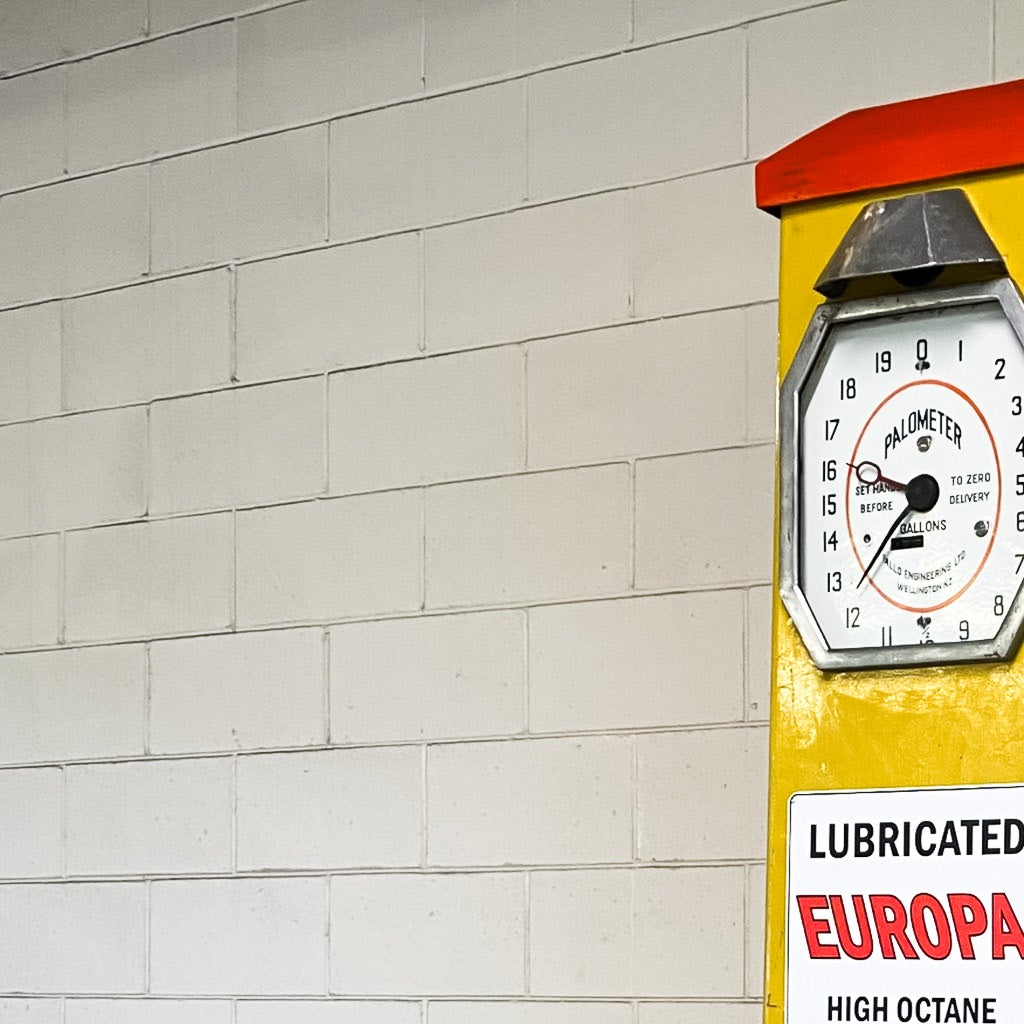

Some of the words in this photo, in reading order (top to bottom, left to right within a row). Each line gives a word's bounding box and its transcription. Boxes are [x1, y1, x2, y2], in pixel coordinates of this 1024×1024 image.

[916, 338, 928, 361] 0
[958, 340, 963, 362] 1
[875, 351, 892, 373] 19
[994, 358, 1006, 380] 2
[840, 378, 857, 401] 18
[1011, 396, 1022, 416] 3
[825, 419, 840, 441] 17
[884, 408, 963, 460] PALOMETER
[822, 459, 837, 482] 16
[950, 475, 963, 486] TO
[966, 472, 991, 485] ZERO
[822, 494, 837, 516] 15
[860, 501, 894, 513] BEFORE
[949, 491, 991, 505] DELIVERY
[823, 531, 838, 552] 14
[827, 571, 842, 593] 13
[993, 595, 1004, 617] 8
[846, 606, 861, 629] 12
[881, 625, 893, 647] 11
[958, 619, 970, 641] 9
[827, 995, 889, 1022] HIGH
[897, 997, 998, 1024] OCTANE
